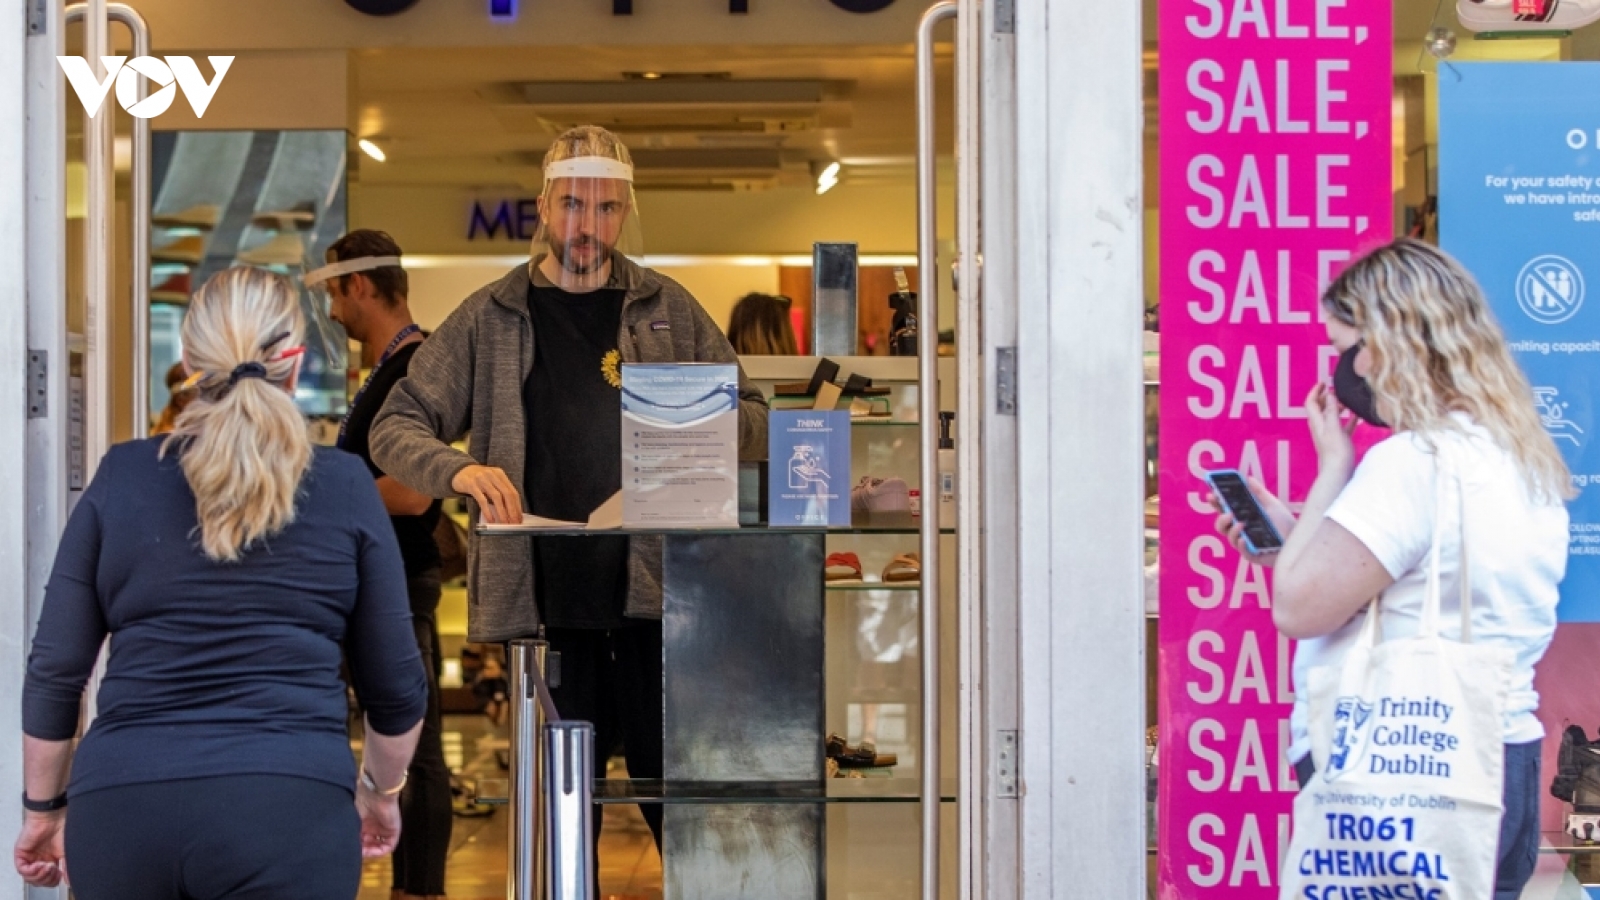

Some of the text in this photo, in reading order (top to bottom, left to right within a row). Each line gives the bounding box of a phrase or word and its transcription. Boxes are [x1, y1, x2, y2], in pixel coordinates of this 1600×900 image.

[1186, 59, 1368, 140] SALE,
[1186, 154, 1368, 234] SALE,
[1485, 175, 1508, 187] For
[1512, 177, 1544, 190] your
[1547, 175, 1592, 190] safety
[1504, 194, 1526, 204] we
[1528, 192, 1565, 204] have
[467, 199, 538, 240] ME
[1509, 340, 1549, 355] miting
[796, 419, 825, 428] THINK
[1379, 696, 1454, 724] Trinity
[1373, 724, 1459, 752] College
[1369, 754, 1451, 778] Dublin
[1389, 794, 1405, 807] of
[1408, 794, 1457, 810] Dublin
[1326, 813, 1414, 841] TR061
[1299, 849, 1449, 881] CHEMICAL
